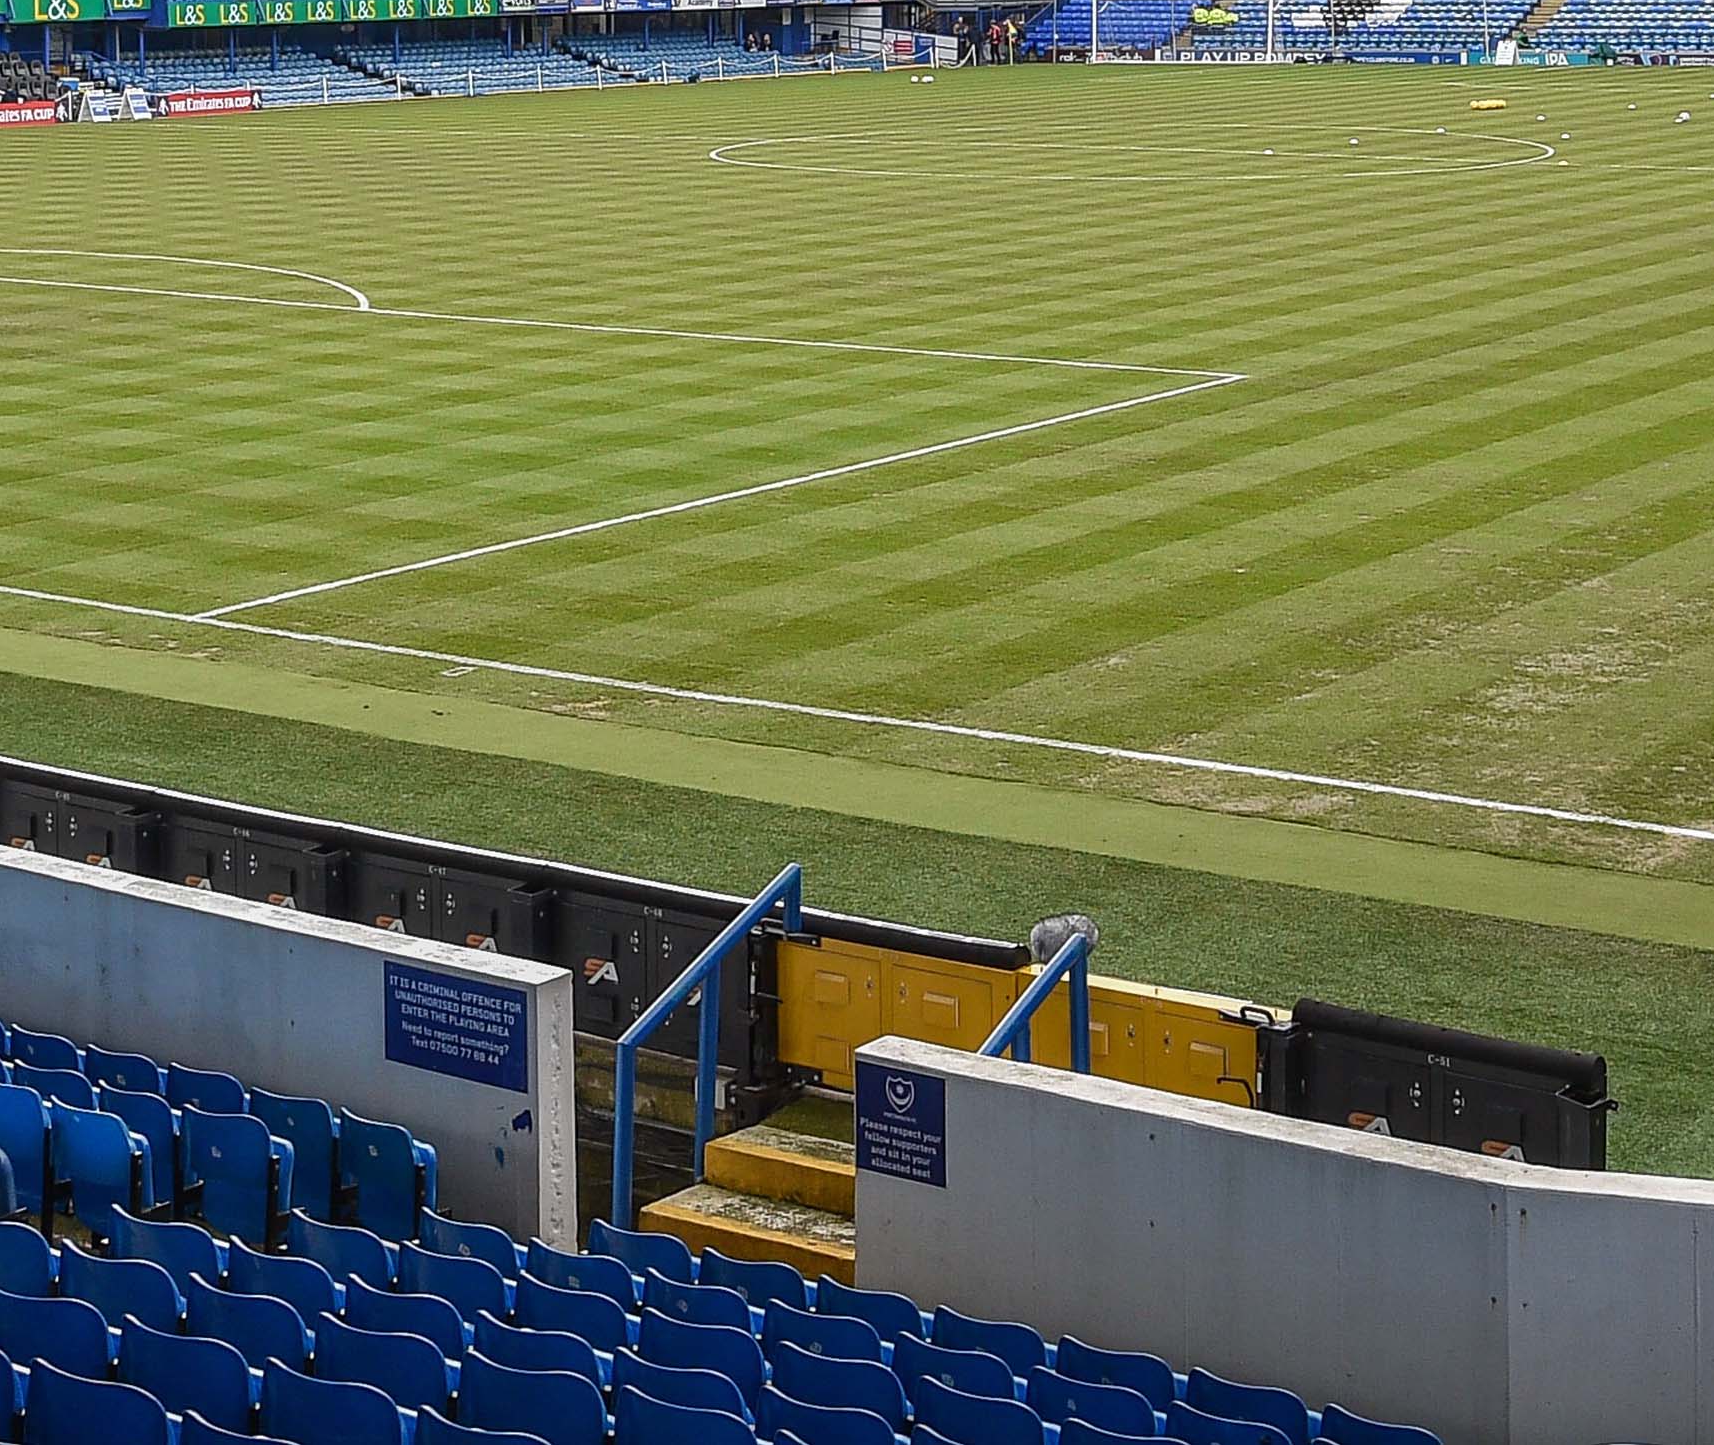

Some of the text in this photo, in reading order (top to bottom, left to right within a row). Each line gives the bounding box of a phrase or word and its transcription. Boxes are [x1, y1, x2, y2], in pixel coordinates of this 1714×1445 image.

[175, 4, 204, 25] L&S
[219, 3, 248, 24] L&S
[266, 2, 293, 23] L&S
[307, 1, 334, 21] L&S
[350, 0, 375, 20] L&S
[389, 0, 414, 18] L&S
[1180, 51, 1222, 62] PLAY
[1228, 51, 1251, 62] UP
[169, 95, 251, 112] THE Emirates FA CUP
[21, 110, 32, 121] FA
[33, 109, 54, 121] CUP
[390, 976, 399, 986] IT
[400, 978, 409, 988] IS
[418, 981, 460, 1001] CRIMINAL
[461, 991, 502, 1010] OFFENCE
[503, 1000, 522, 1013] FOR
[395, 990, 515, 1026] UNAUTHORISED PERSONS TO
[401, 1004, 509, 1037] ENTER THE PLAYING AREA
[402, 1020, 509, 1055] Need to report something?
[411, 1036, 429, 1049] Text
[429, 1040, 458, 1055] 07500
[460, 1046, 471, 1058] 77
[487, 1053, 500, 1065] 44
[860, 1117, 942, 1145] Please respect your
[864, 1131, 938, 1156] fellow supporters
[871, 1157, 931, 1179] allocated seat
[888, 1149, 899, 1160] sit
[901, 1151, 911, 1161] in
[912, 1155, 931, 1167] your
